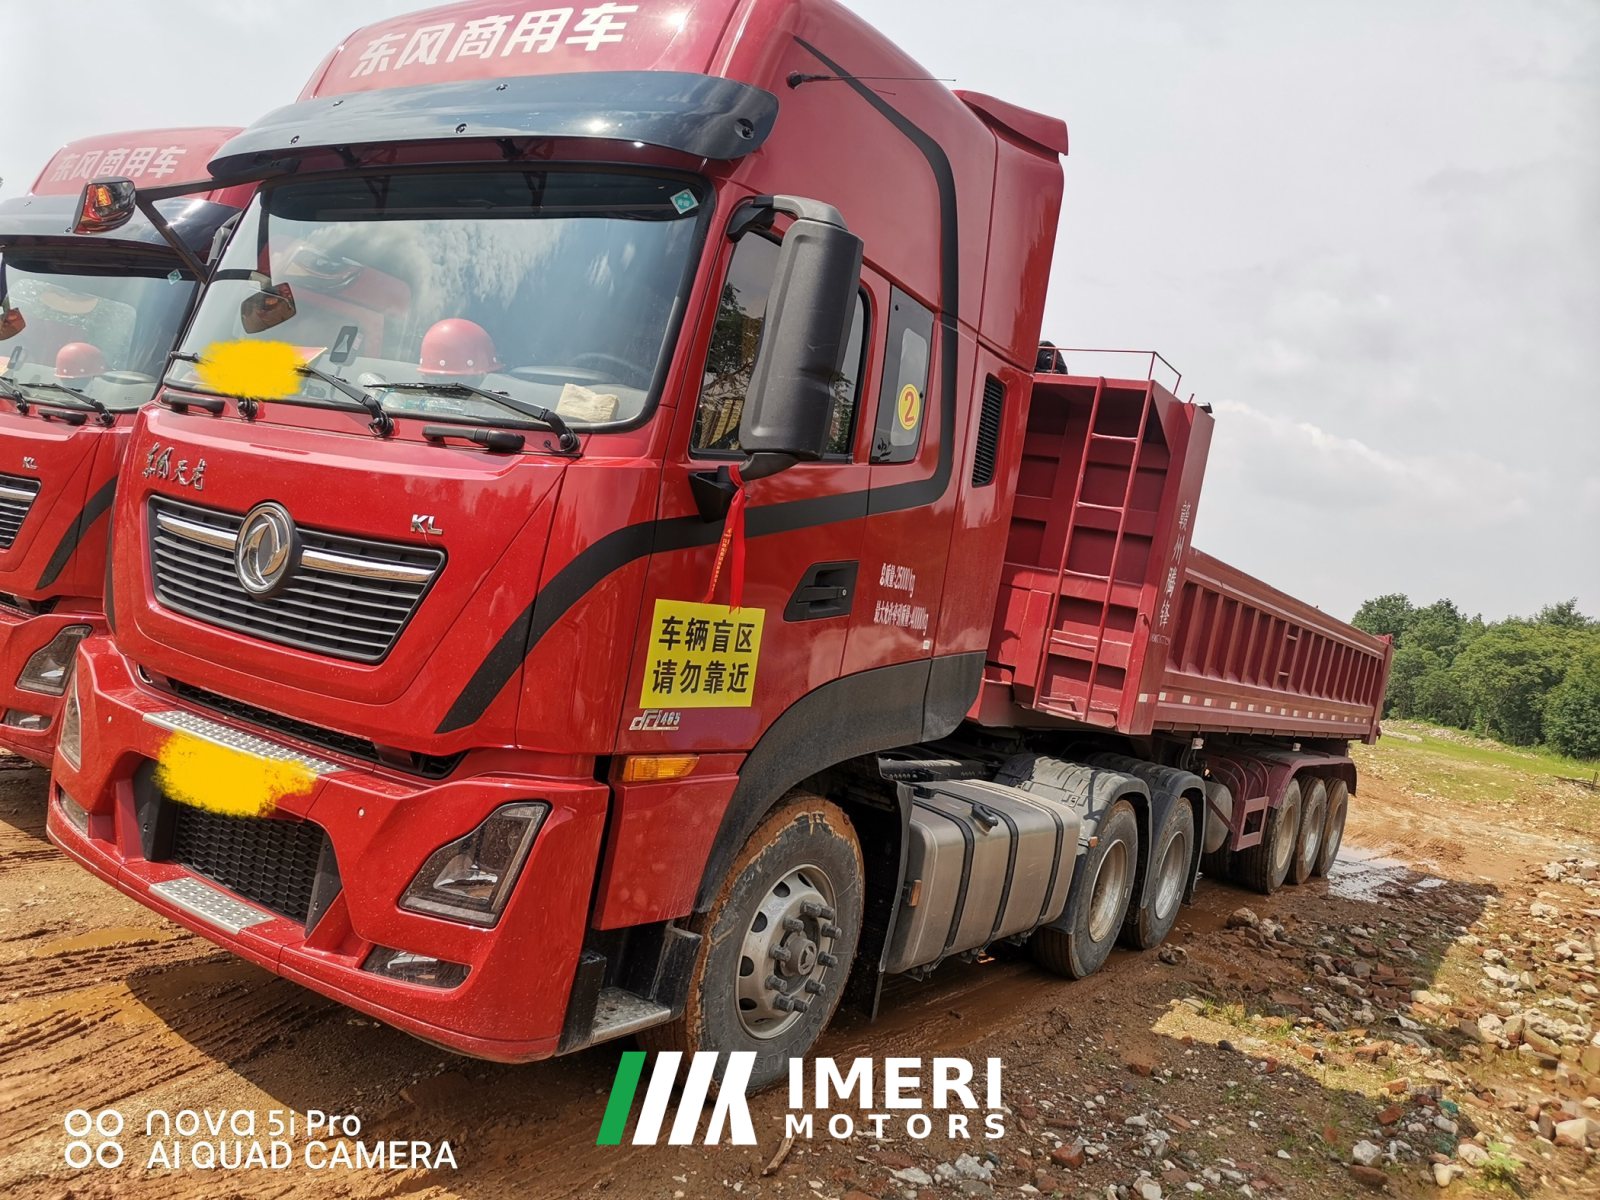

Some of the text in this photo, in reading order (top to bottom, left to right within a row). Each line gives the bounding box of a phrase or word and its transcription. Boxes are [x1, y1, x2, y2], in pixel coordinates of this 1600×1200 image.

[350, 2, 639, 78] 东风商用车
[51, 146, 187, 181] 东风商用车
[904, 391, 915, 422] 2
[23, 456, 38, 469] KL
[411, 514, 443, 535] KL
[659, 615, 755, 653] 车辆盲区
[652, 659, 749, 694] 请勿靠近
